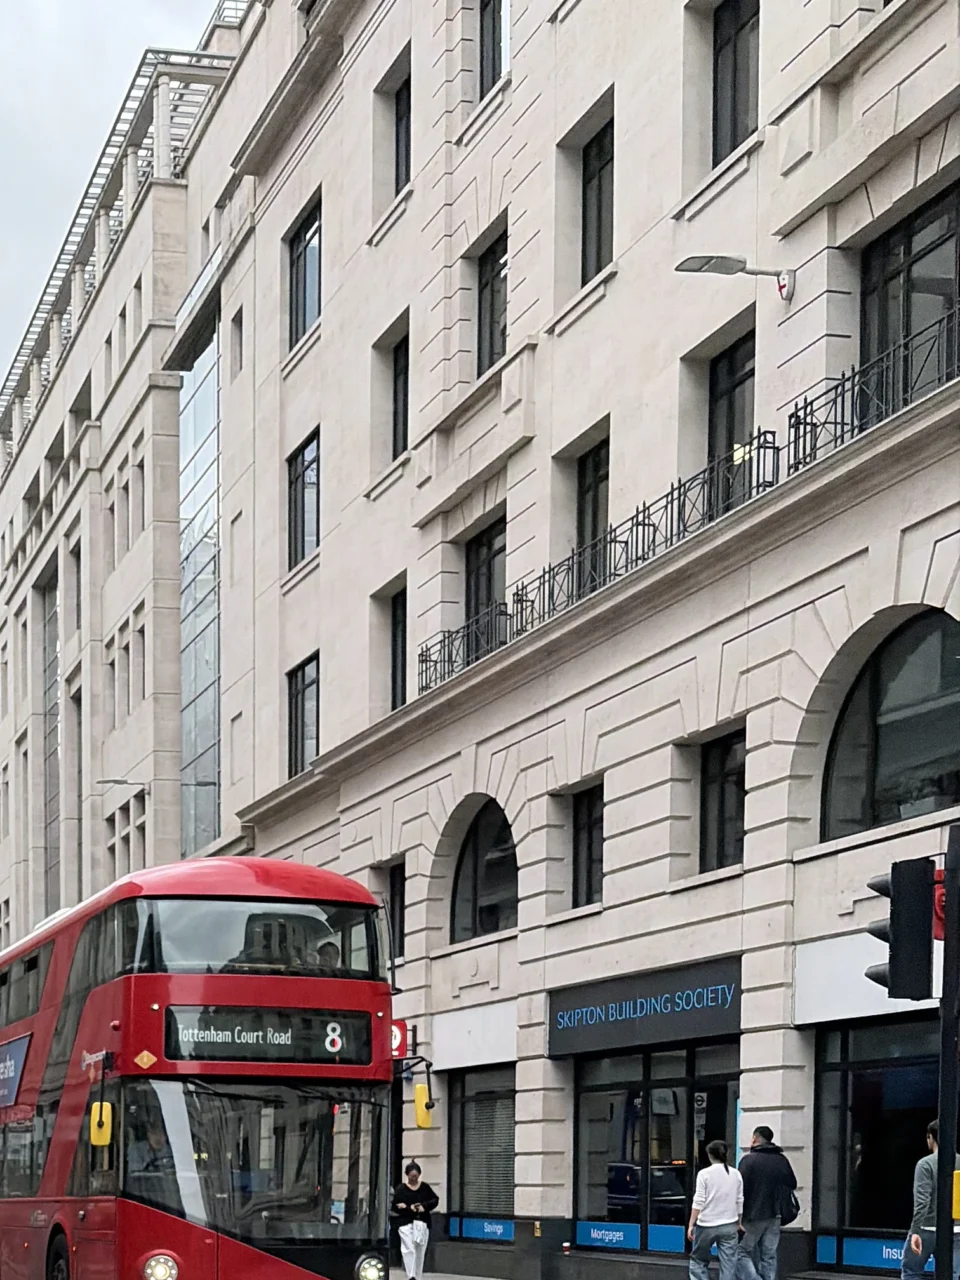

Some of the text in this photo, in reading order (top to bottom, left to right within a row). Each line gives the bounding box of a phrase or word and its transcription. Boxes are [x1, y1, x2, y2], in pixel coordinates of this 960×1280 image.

[557, 983, 736, 1029] SKIPTON BUILDING SOCIETY
[178, 1022, 343, 1053] Tottenham Court Road 8
[483, 1222, 503, 1235] Savings
[590, 1228, 624, 1242] Mortgages
